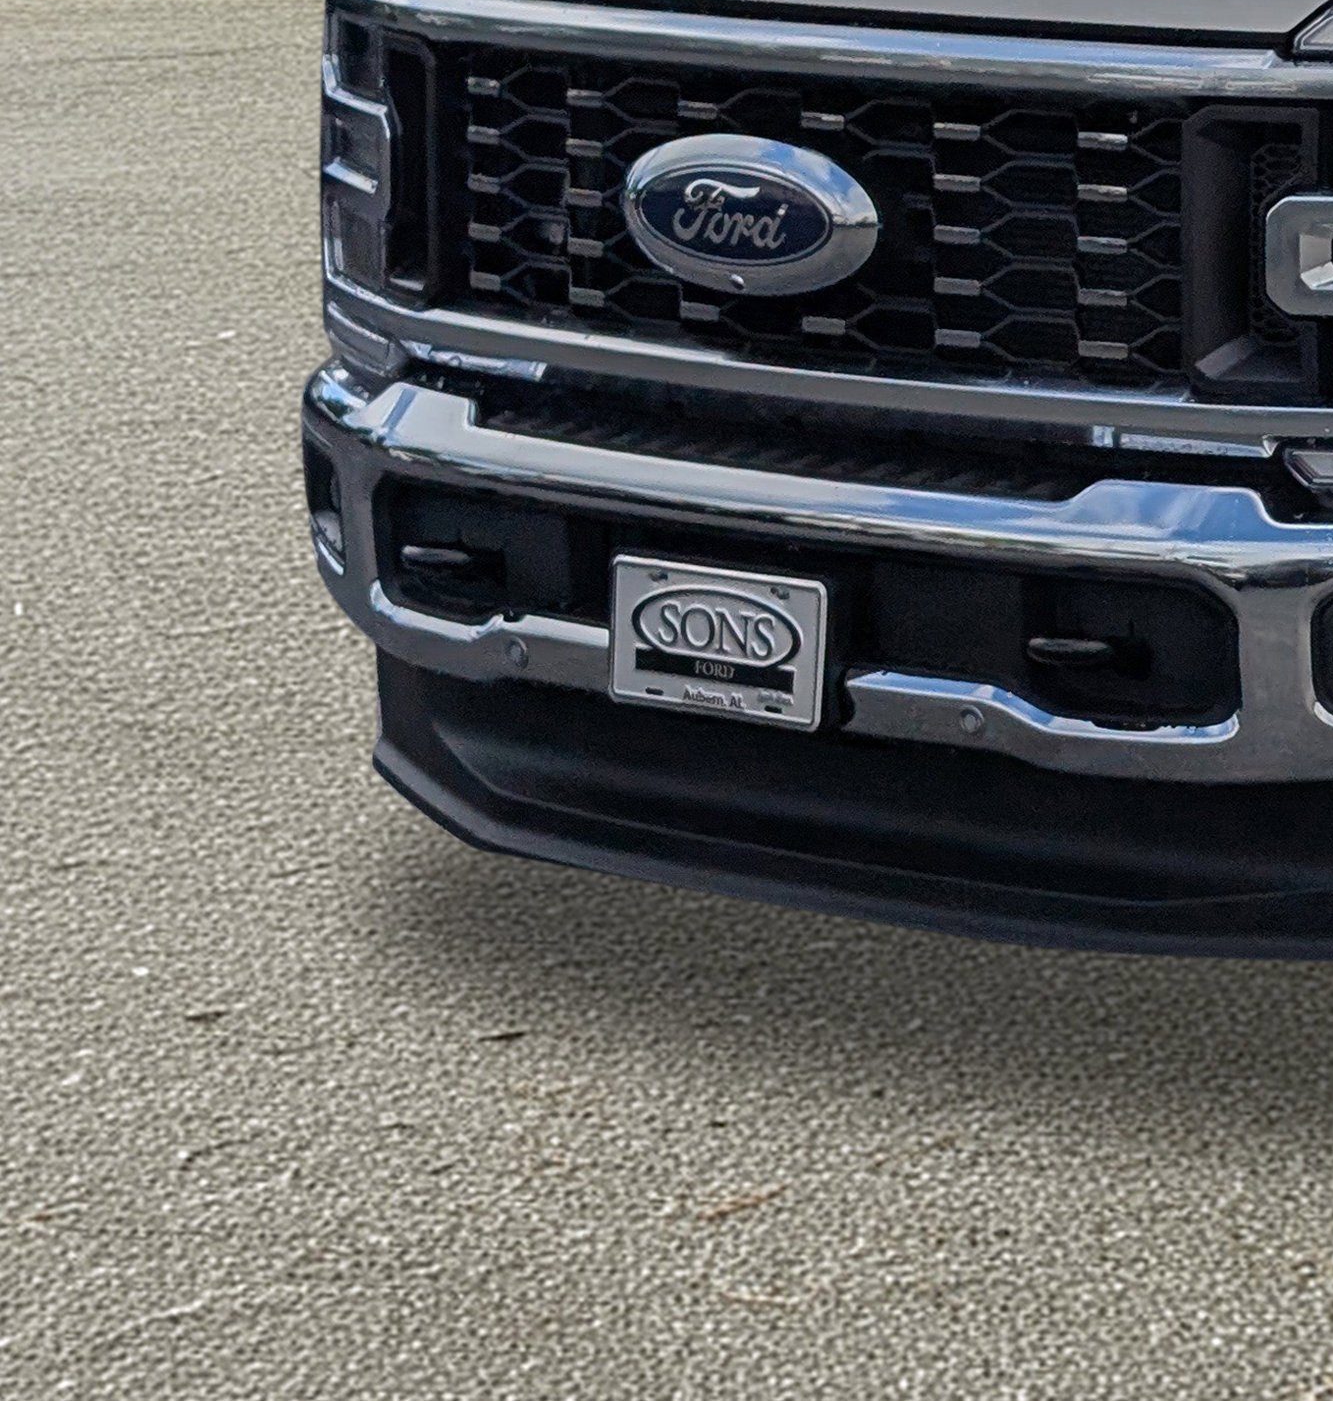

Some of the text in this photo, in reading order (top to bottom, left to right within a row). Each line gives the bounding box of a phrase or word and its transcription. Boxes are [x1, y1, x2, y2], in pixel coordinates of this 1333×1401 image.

[672, 177, 788, 249] Ford
[658, 602, 776, 659] SONS
[695, 660, 736, 679] FORD
